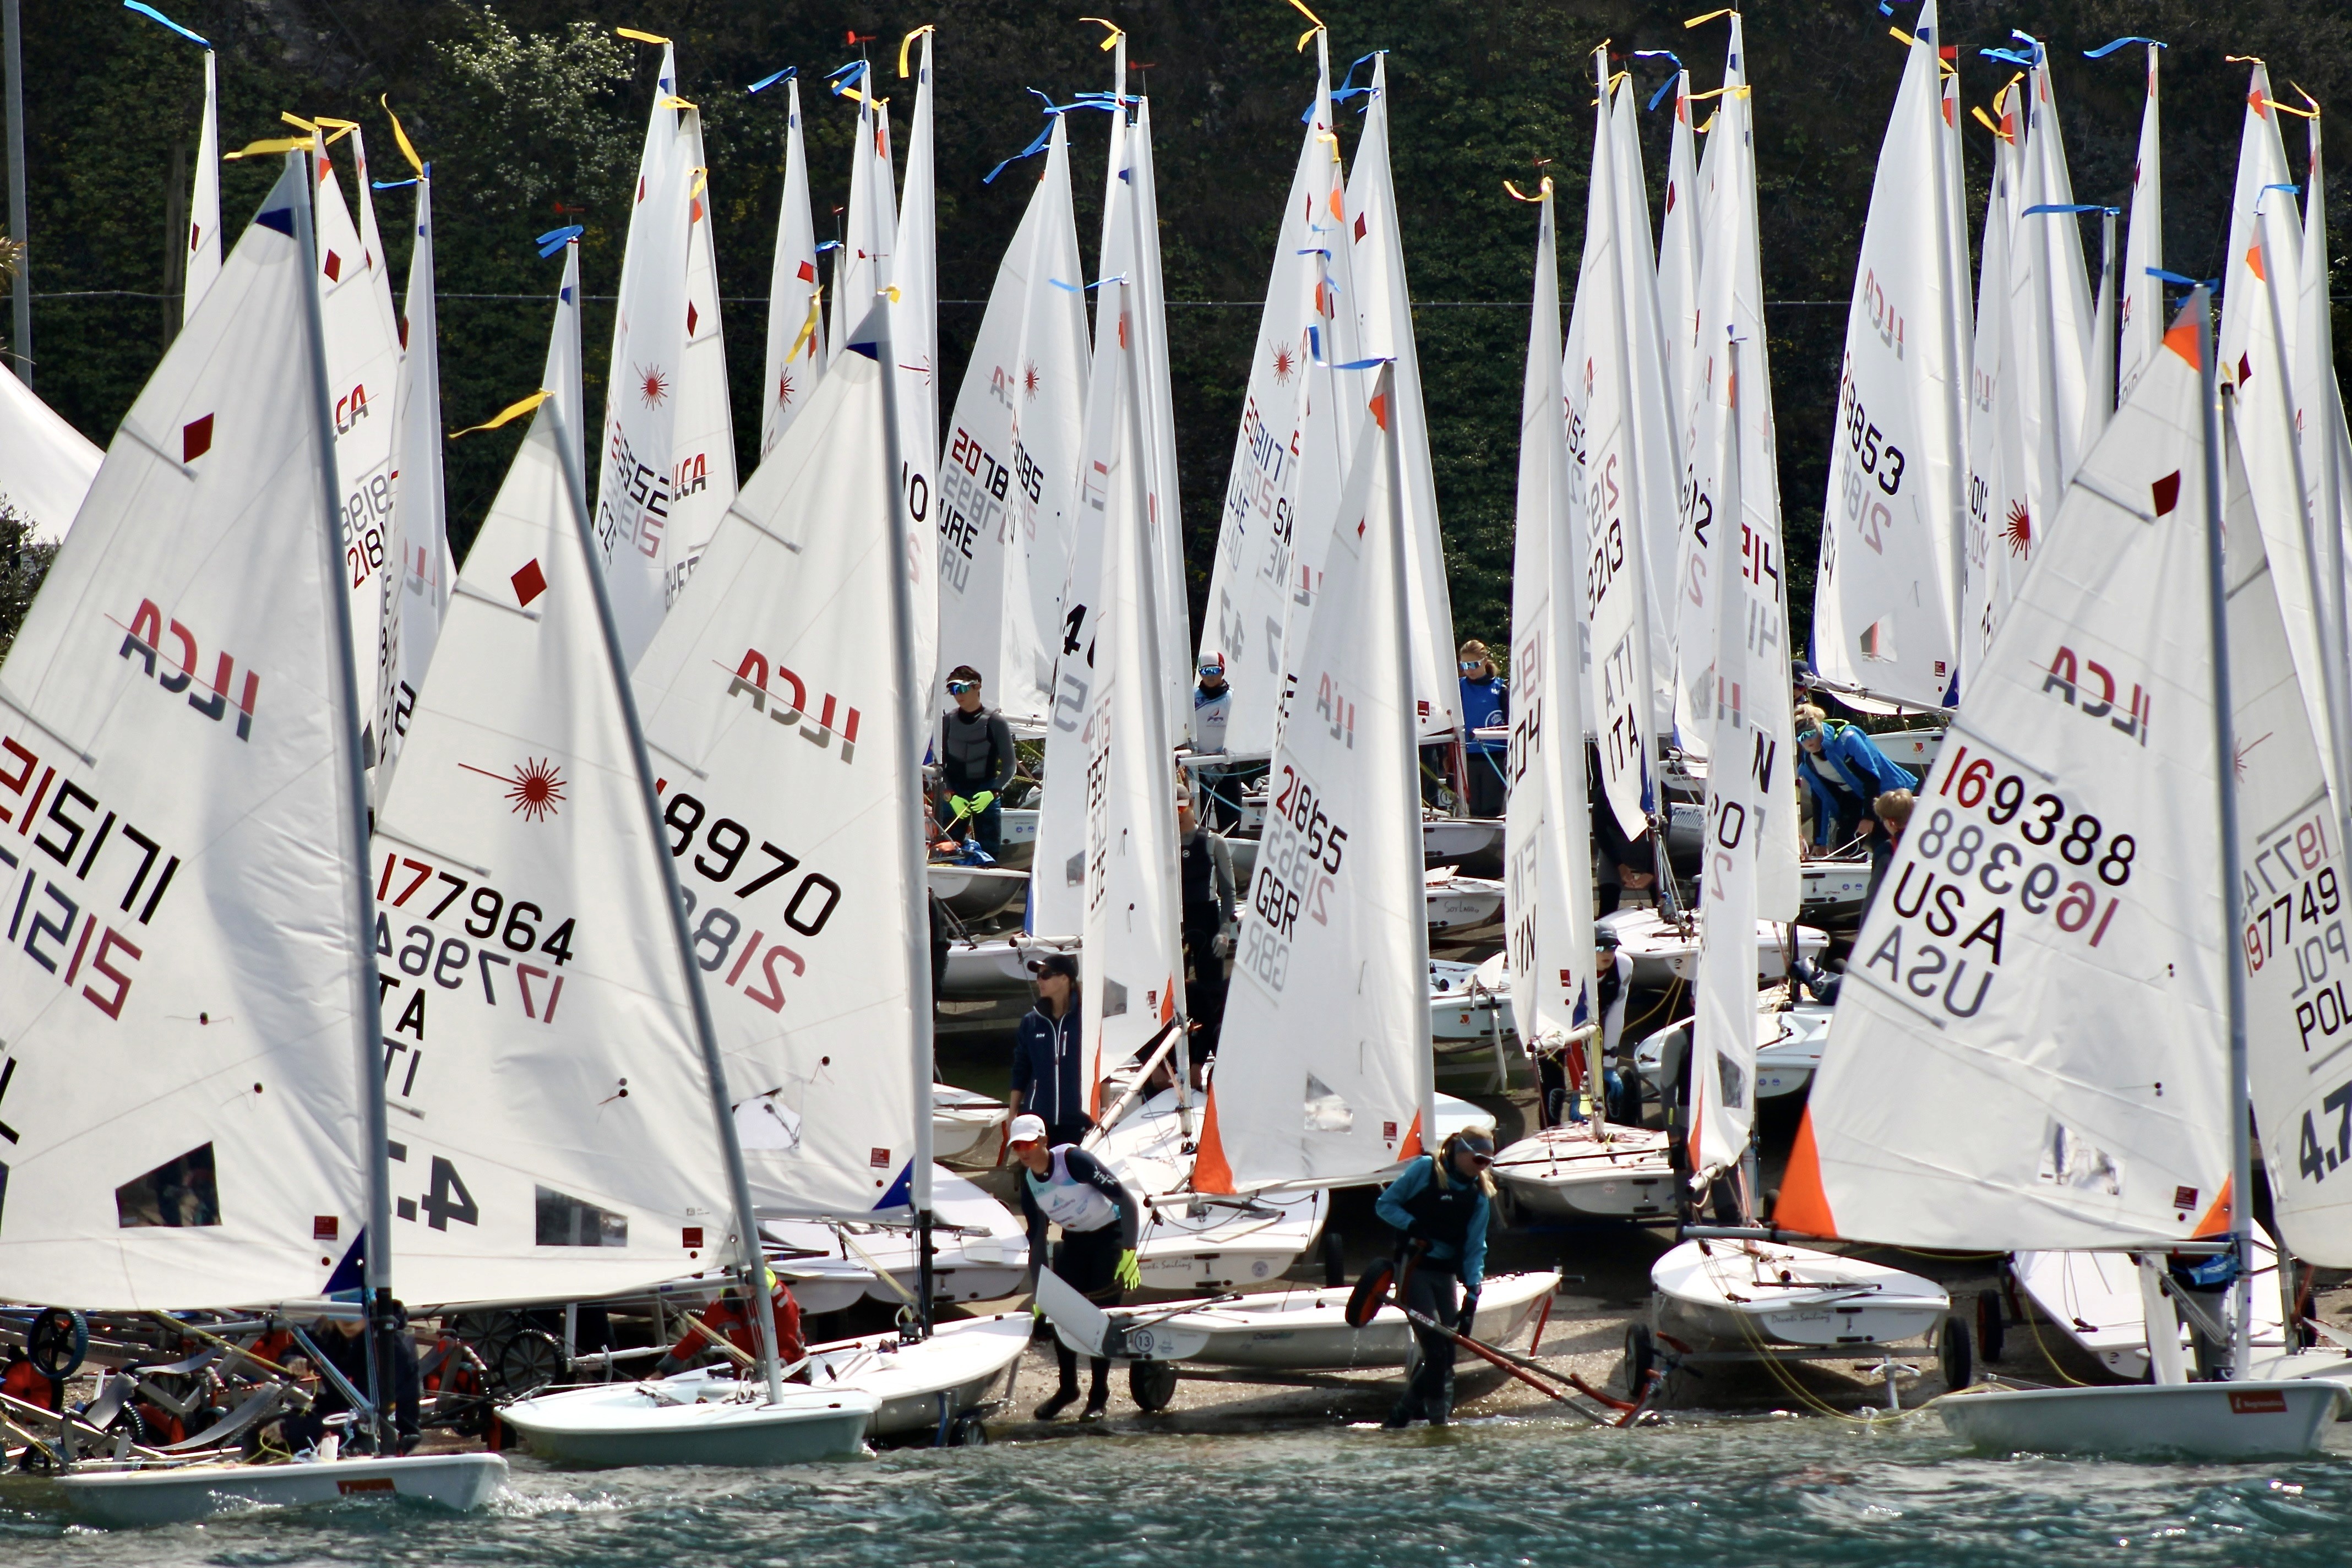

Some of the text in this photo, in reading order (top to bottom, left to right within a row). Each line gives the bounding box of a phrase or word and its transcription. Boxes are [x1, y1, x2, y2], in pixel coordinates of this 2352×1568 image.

[1843, 351, 1904, 496] 218853
[1608, 703, 1639, 783] ITA
[656, 777, 841, 937] 8970
[1940, 746, 2136, 886] 169388
[377, 853, 576, 966] 177964
[1256, 867, 1299, 942] GBR
[1893, 861, 2005, 966] USA
[2244, 867, 2340, 978] 197749
[2296, 980, 2352, 1052] POL
[2300, 1080, 2352, 1184] 4.7
[1139, 1336, 1151, 1347] 13
